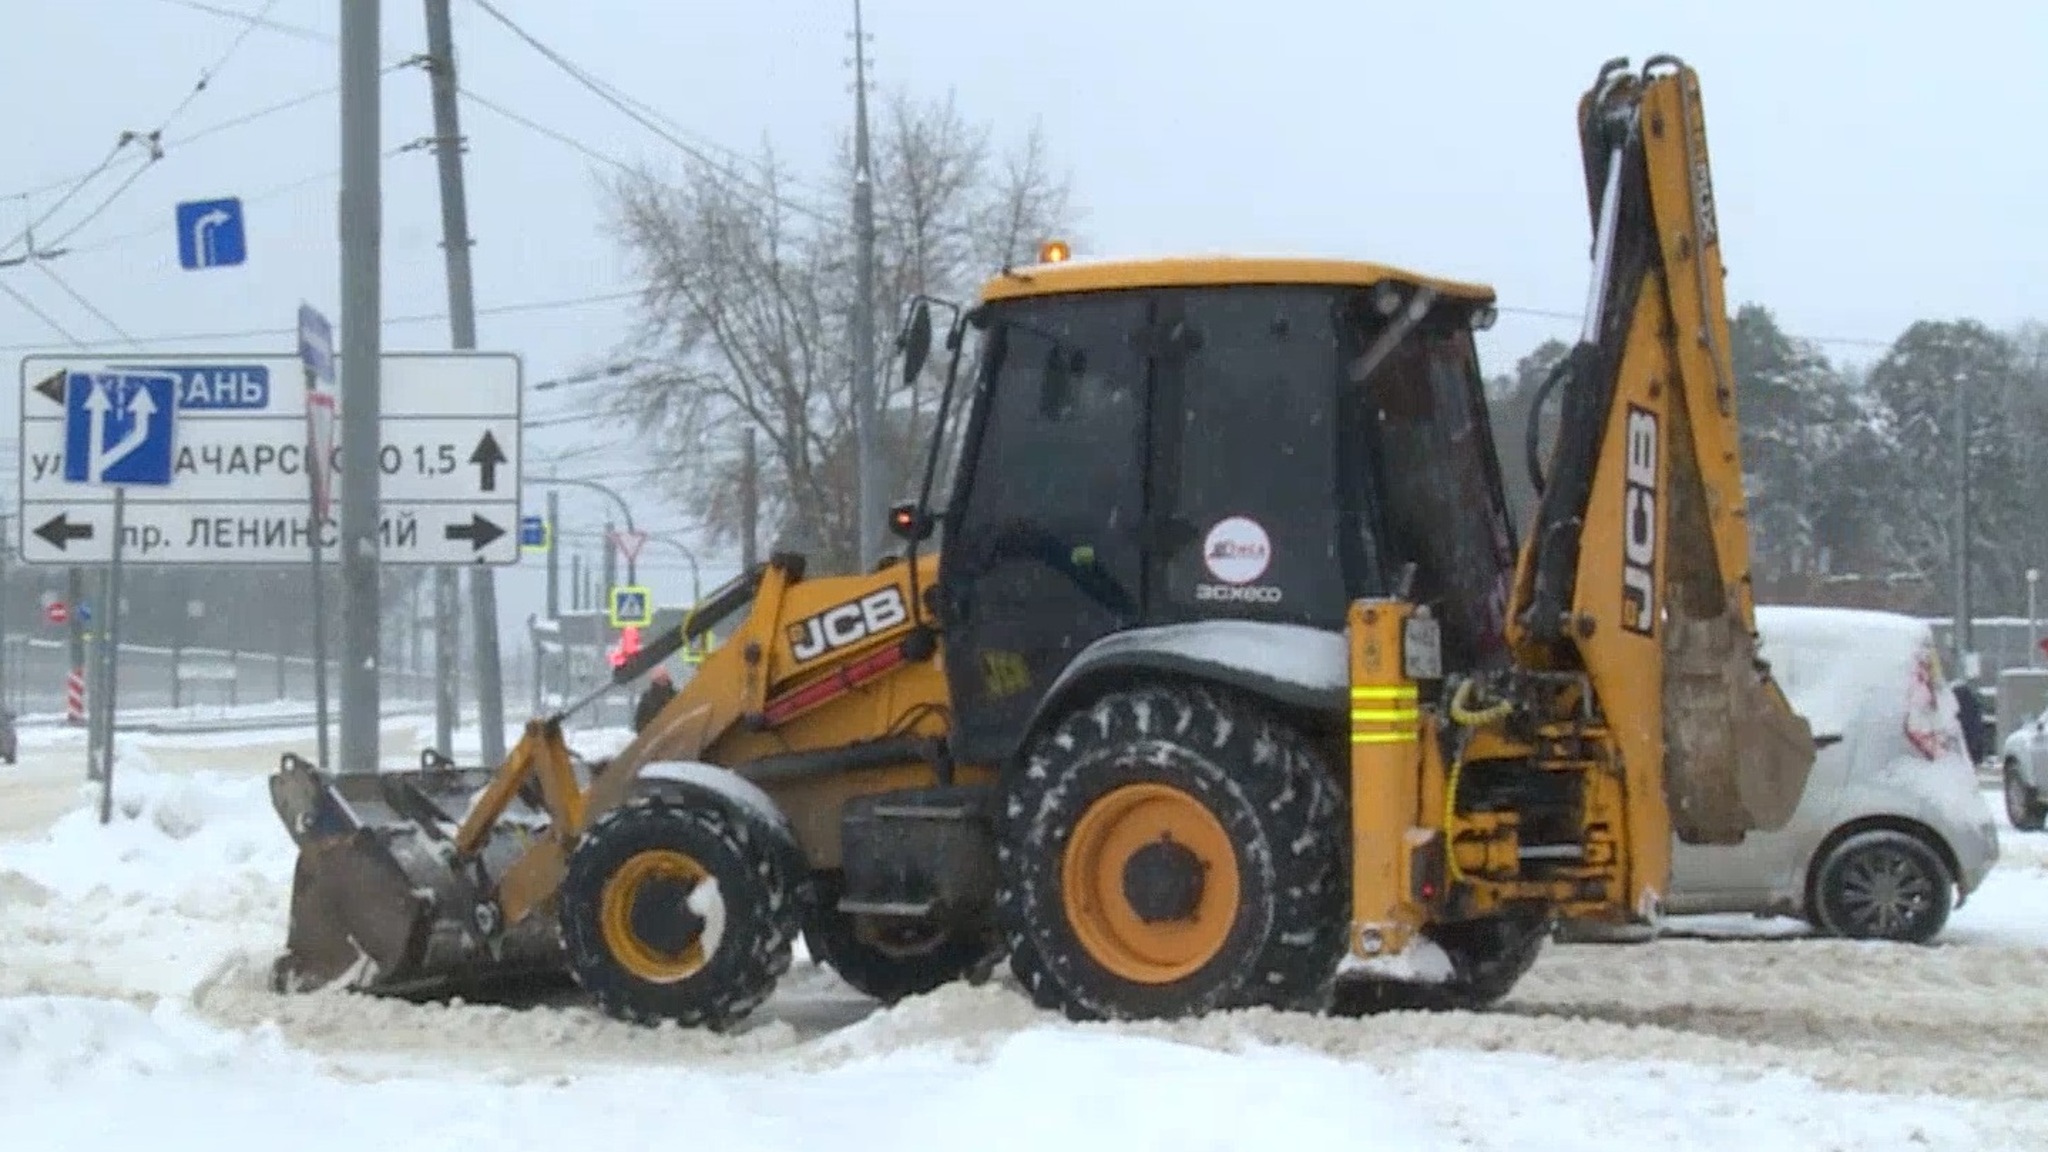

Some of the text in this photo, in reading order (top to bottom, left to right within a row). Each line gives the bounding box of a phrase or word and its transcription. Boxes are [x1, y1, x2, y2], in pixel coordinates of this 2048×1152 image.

[414, 444, 456, 478] 1,5
[120, 510, 417, 555] пр. ЛЕНИНСИЙ
[1625, 410, 1657, 633] JCB
[793, 587, 907, 661] JCB
